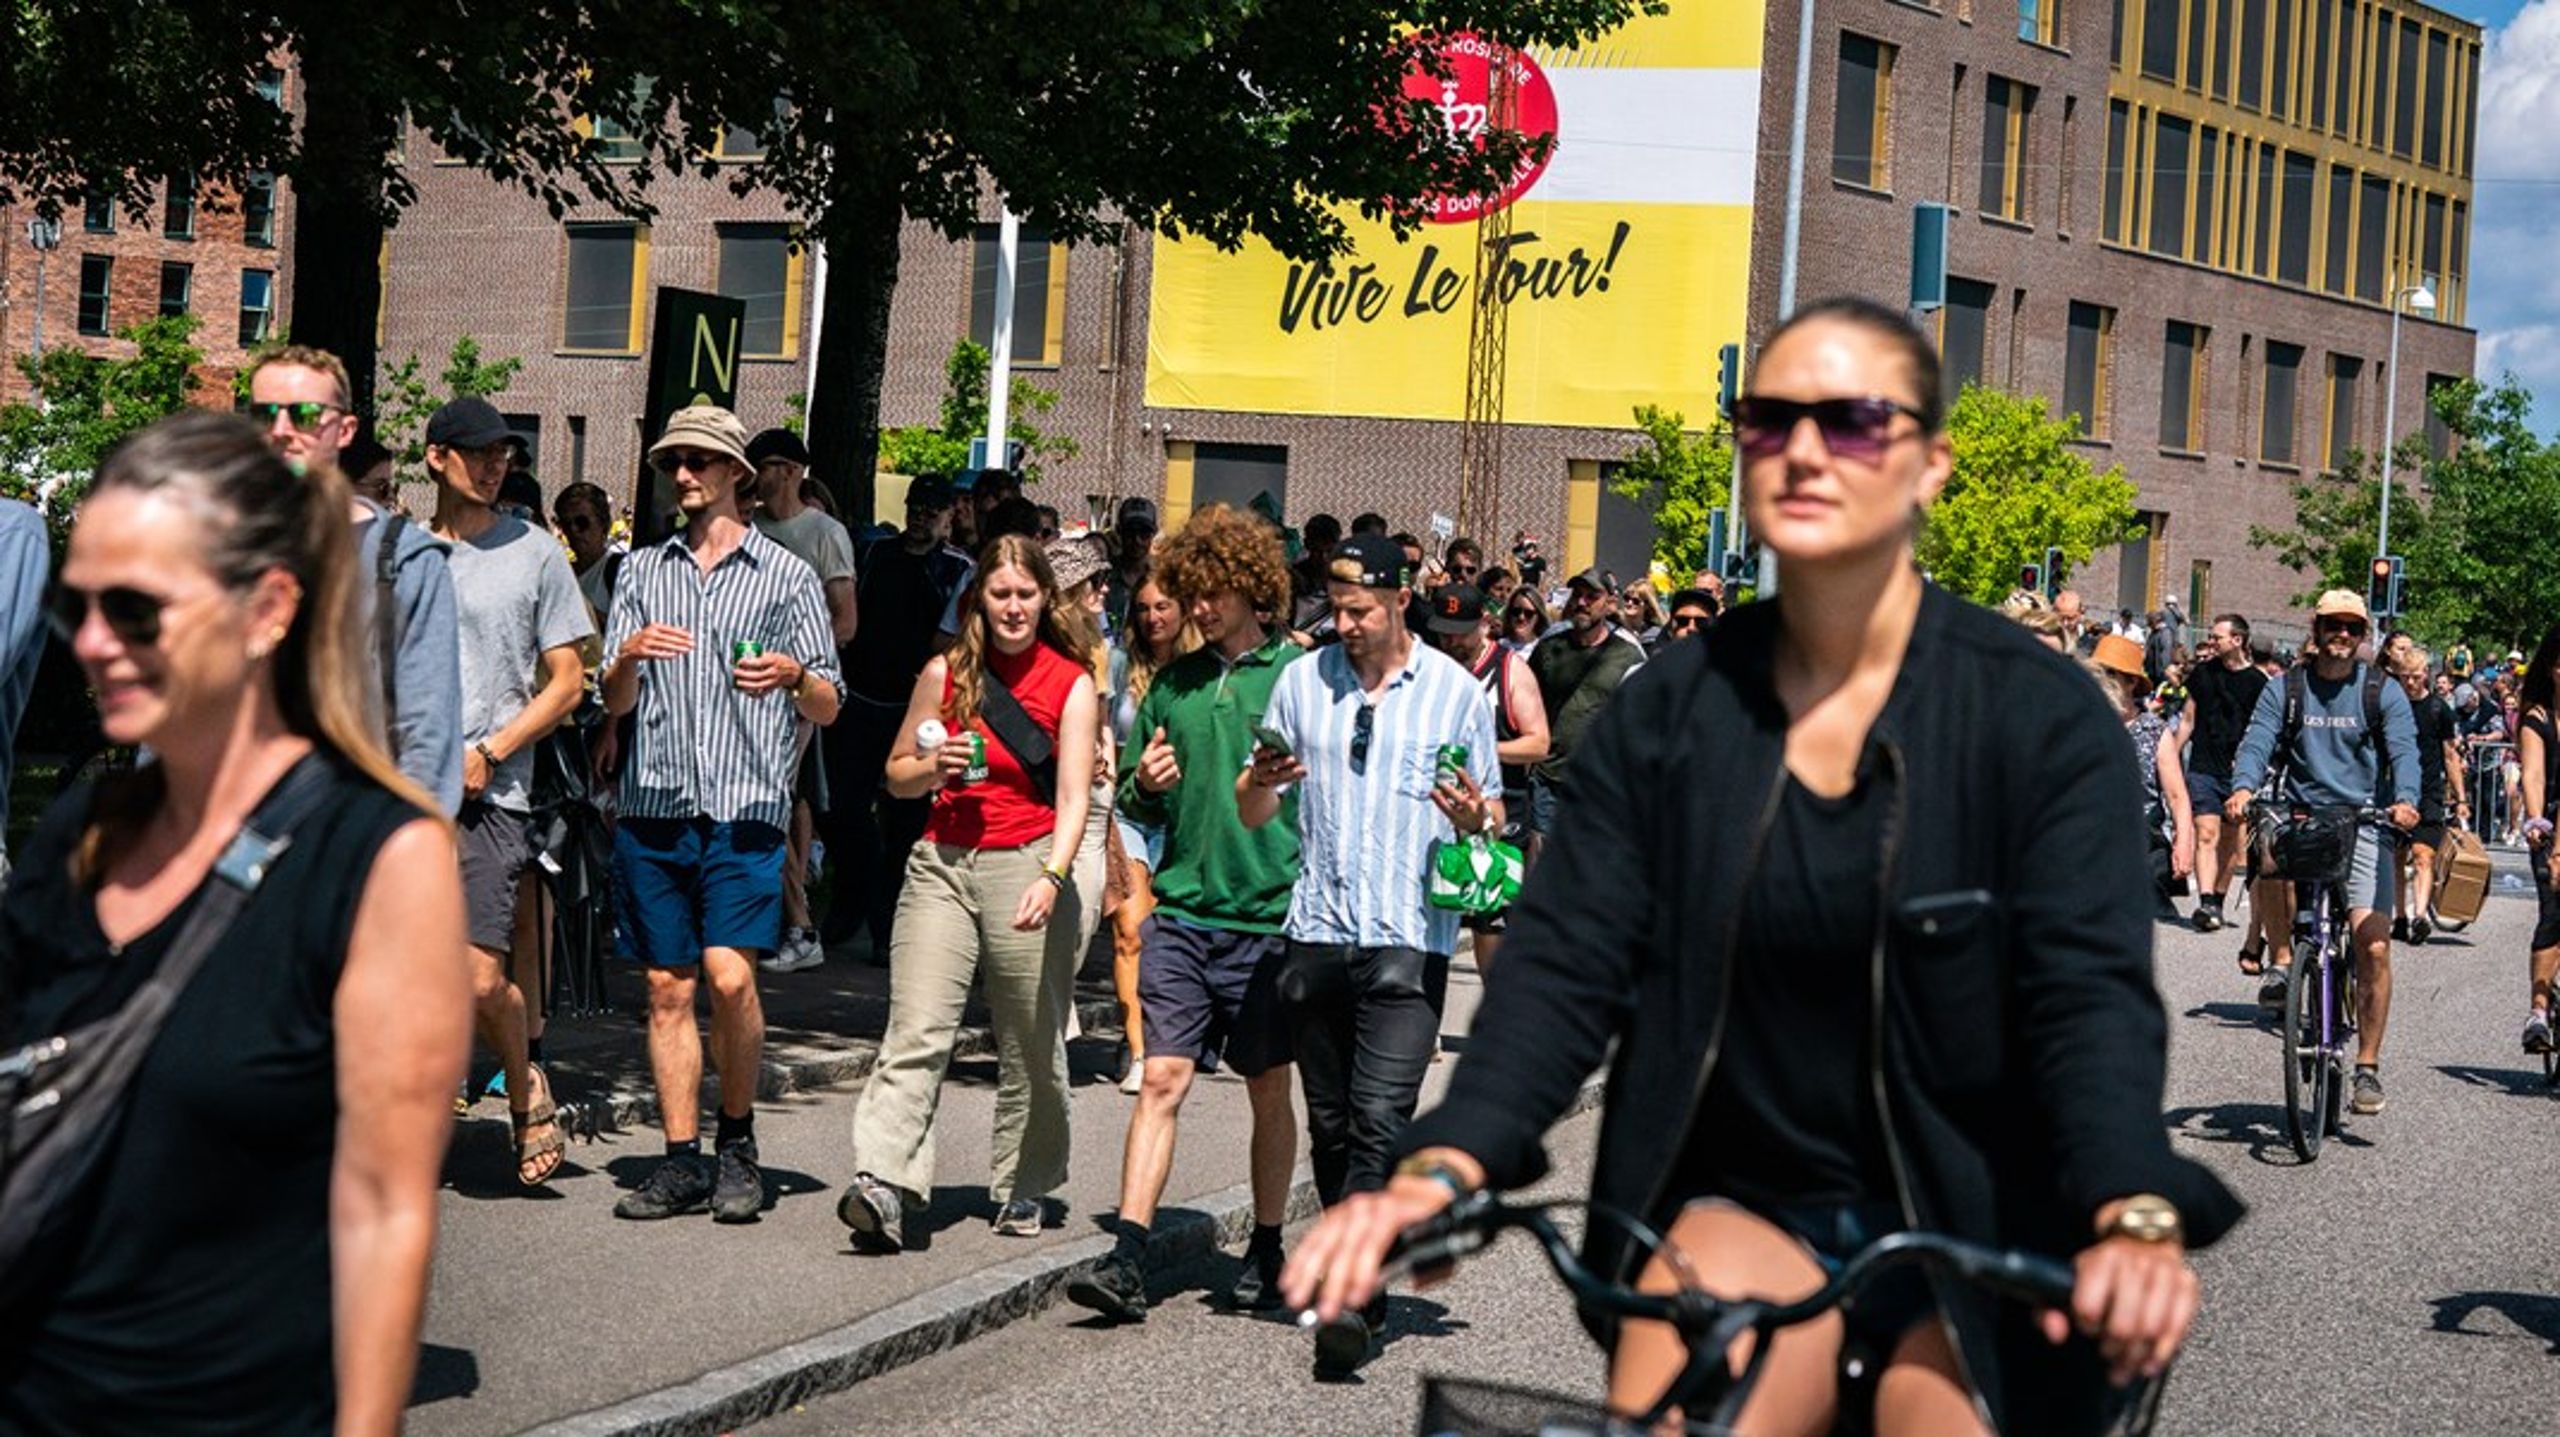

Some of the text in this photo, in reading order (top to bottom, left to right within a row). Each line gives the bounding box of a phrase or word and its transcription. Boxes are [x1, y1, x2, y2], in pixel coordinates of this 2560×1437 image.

[1279, 220, 1631, 334] Vive Le Tour!
[690, 312, 738, 393] N
